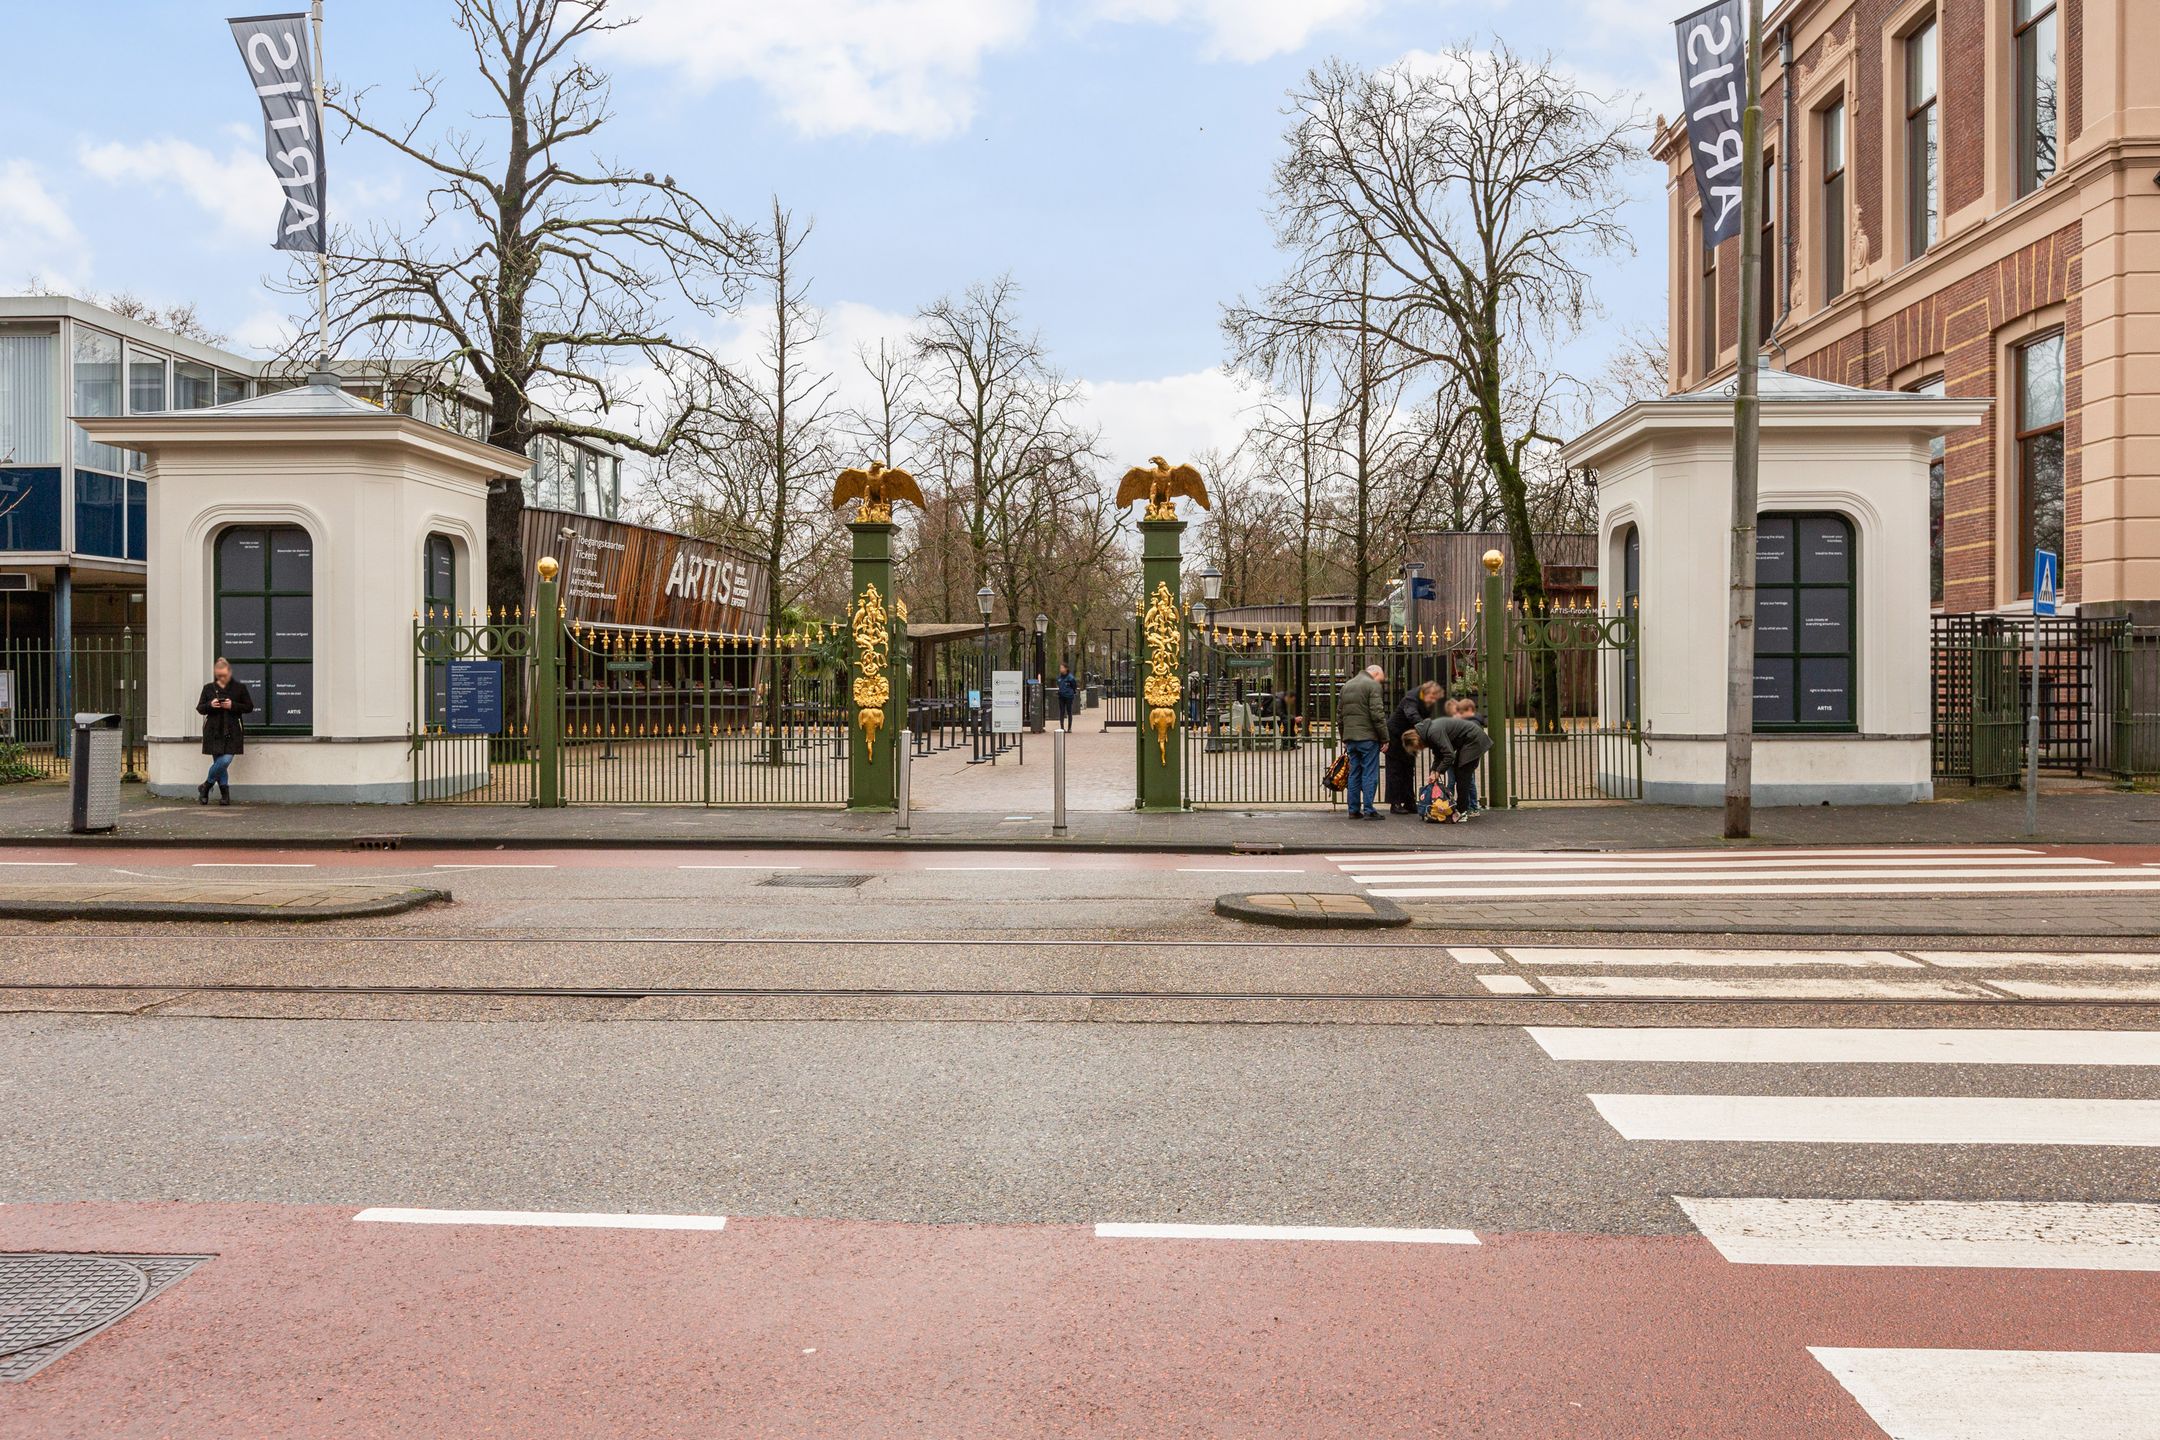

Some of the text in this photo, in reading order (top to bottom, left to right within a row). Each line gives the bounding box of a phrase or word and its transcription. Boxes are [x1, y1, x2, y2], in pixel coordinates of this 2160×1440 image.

[577, 535, 625, 551] Toegangskaarten
[575, 549, 598, 561] Tickets
[664, 551, 734, 605] ARTIS
